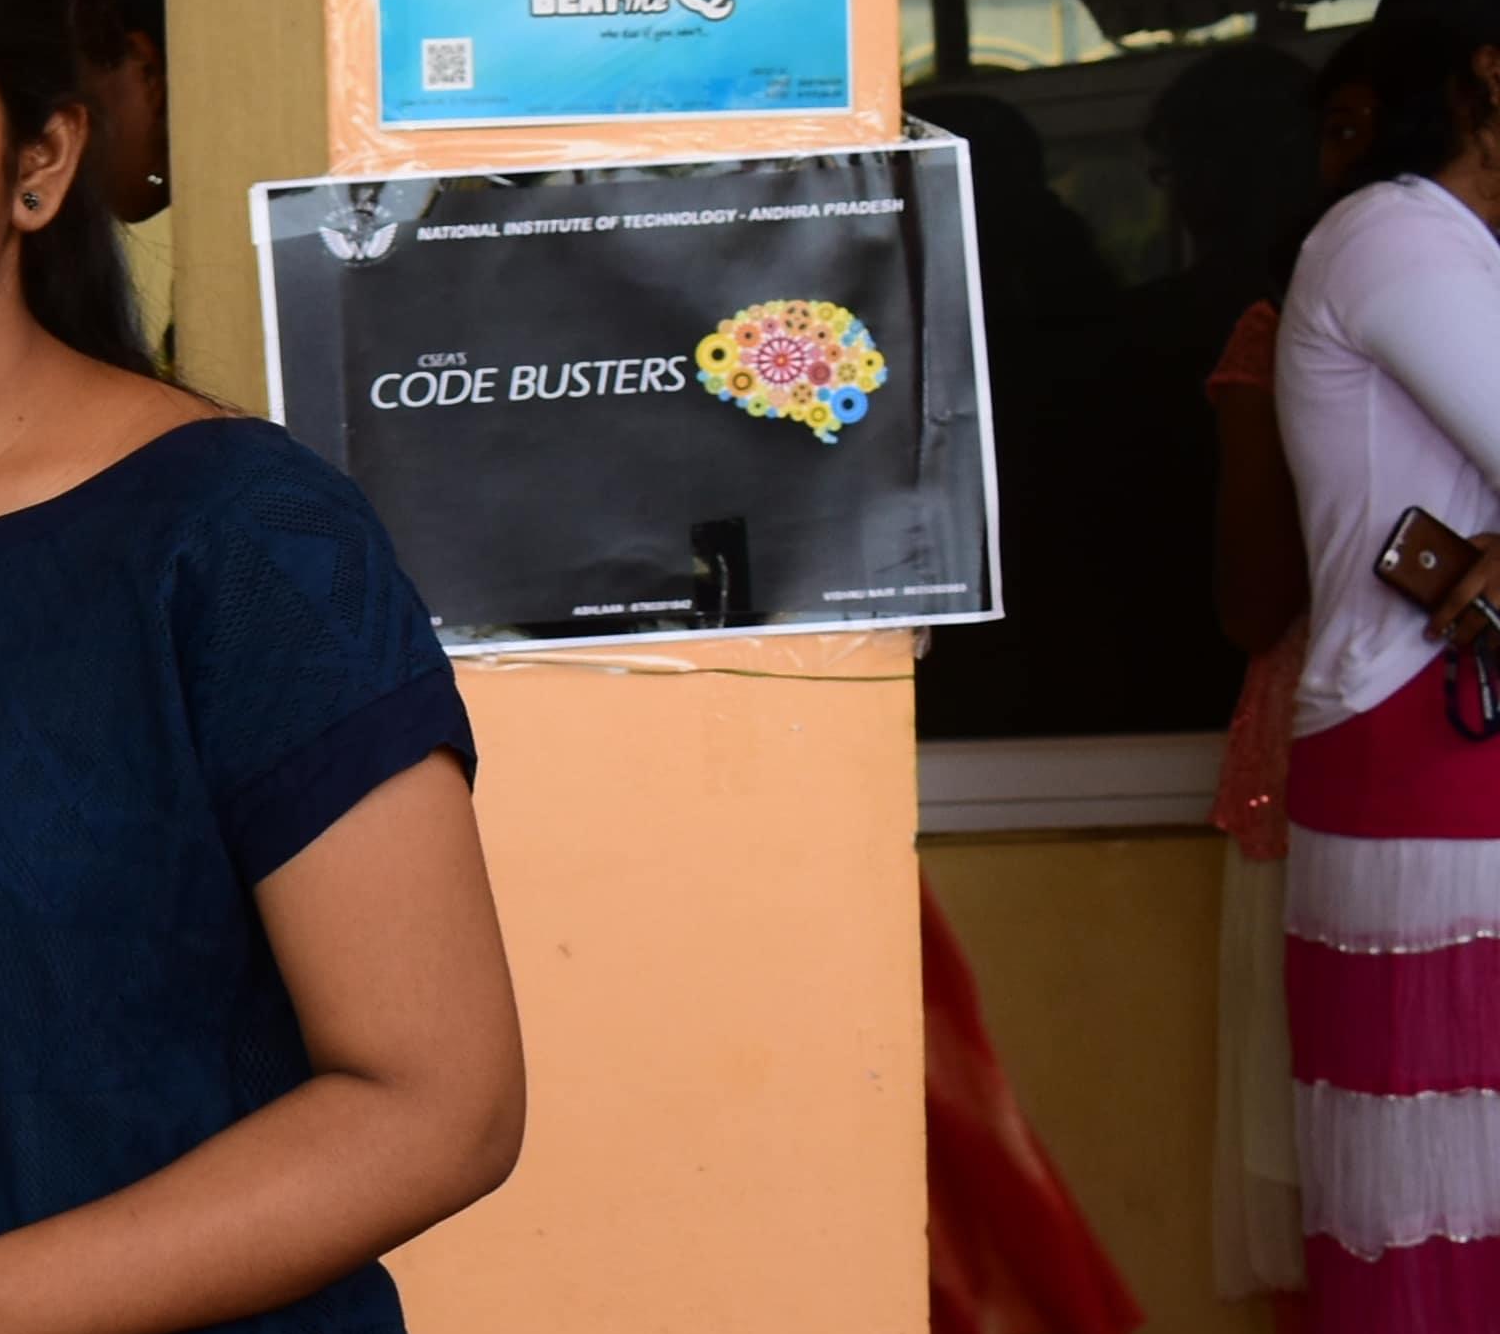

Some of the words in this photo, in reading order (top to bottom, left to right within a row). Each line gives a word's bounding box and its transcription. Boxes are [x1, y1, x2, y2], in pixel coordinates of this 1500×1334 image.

[417, 222, 500, 241] NATIONAL
[503, 216, 593, 237] INSTITUTE
[595, 216, 619, 231] OF
[623, 208, 737, 229] TECHNOLOGY
[748, 203, 821, 222] ANDHRA
[822, 198, 904, 217] PRADESH
[417, 351, 468, 368] CSEA'S
[370, 367, 498, 409] CODE
[508, 355, 688, 401] BUSTERS
